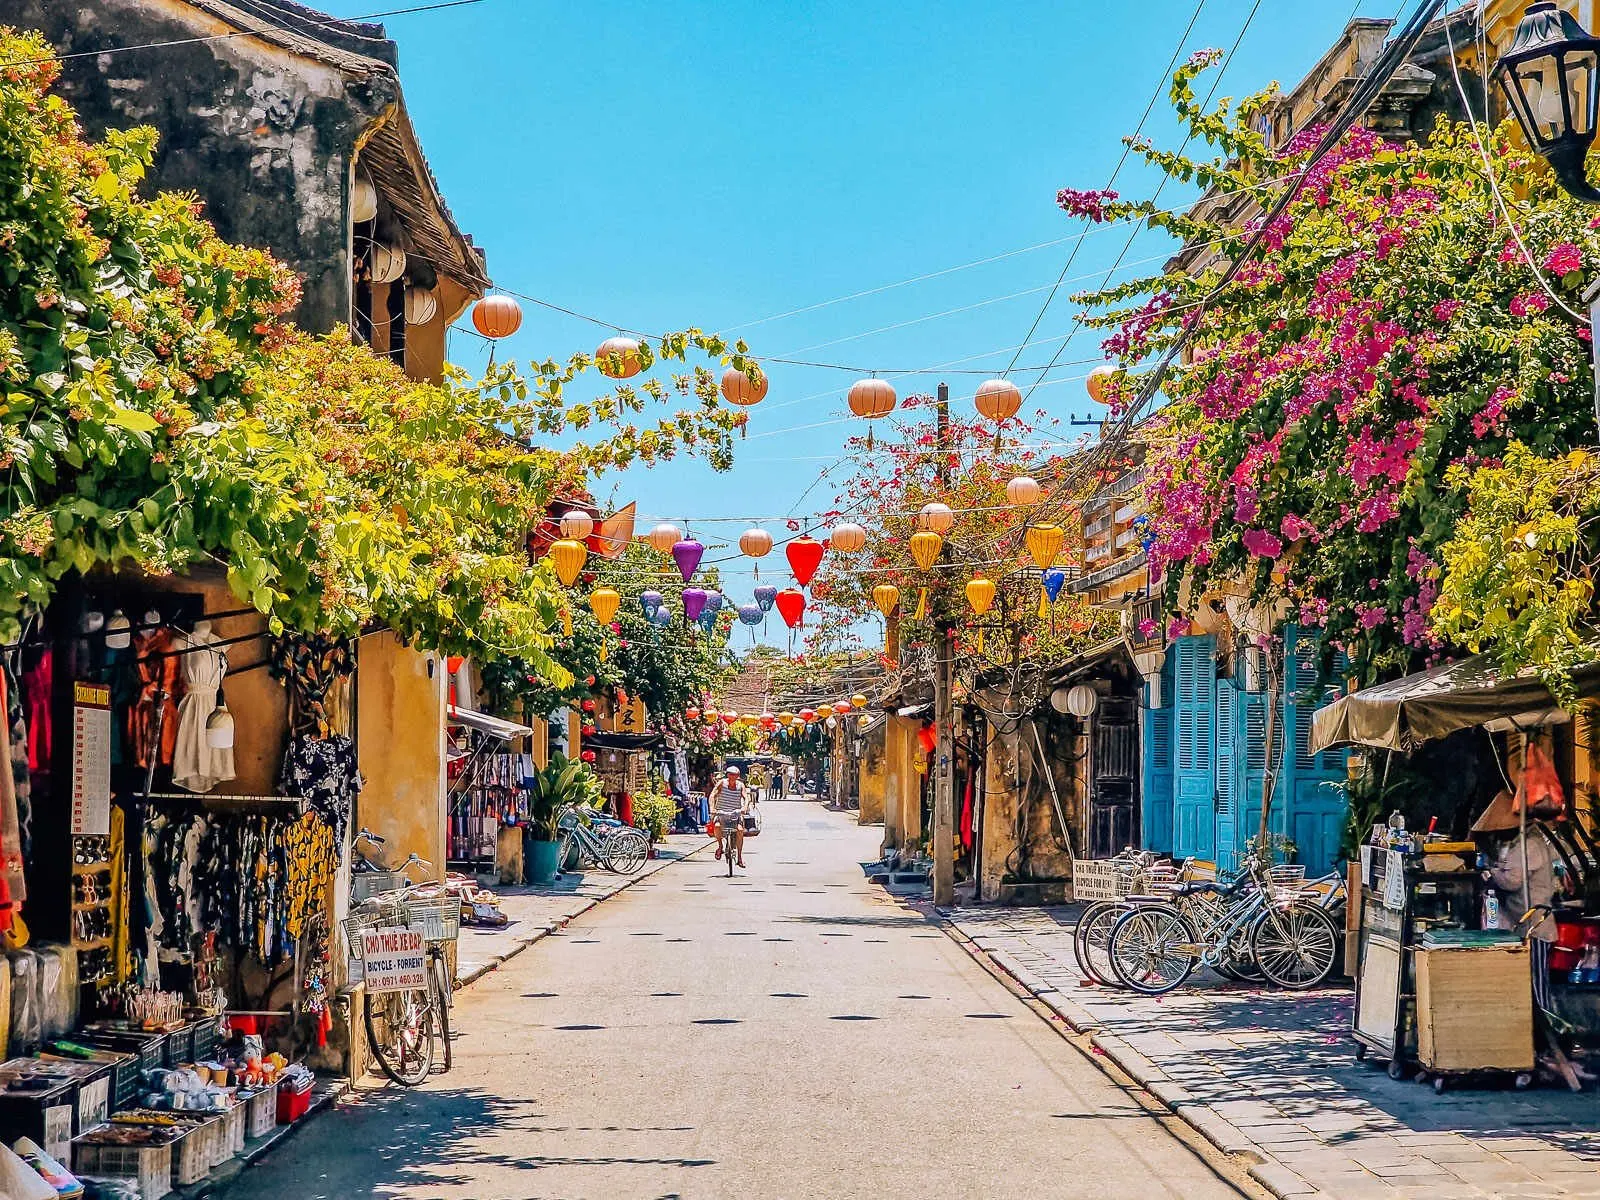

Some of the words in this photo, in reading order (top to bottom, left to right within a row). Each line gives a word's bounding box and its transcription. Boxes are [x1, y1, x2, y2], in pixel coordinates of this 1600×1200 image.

[366, 935, 379, 954] CHO
[400, 933, 408, 951] XE
[368, 960, 392, 972] BICYCLE
